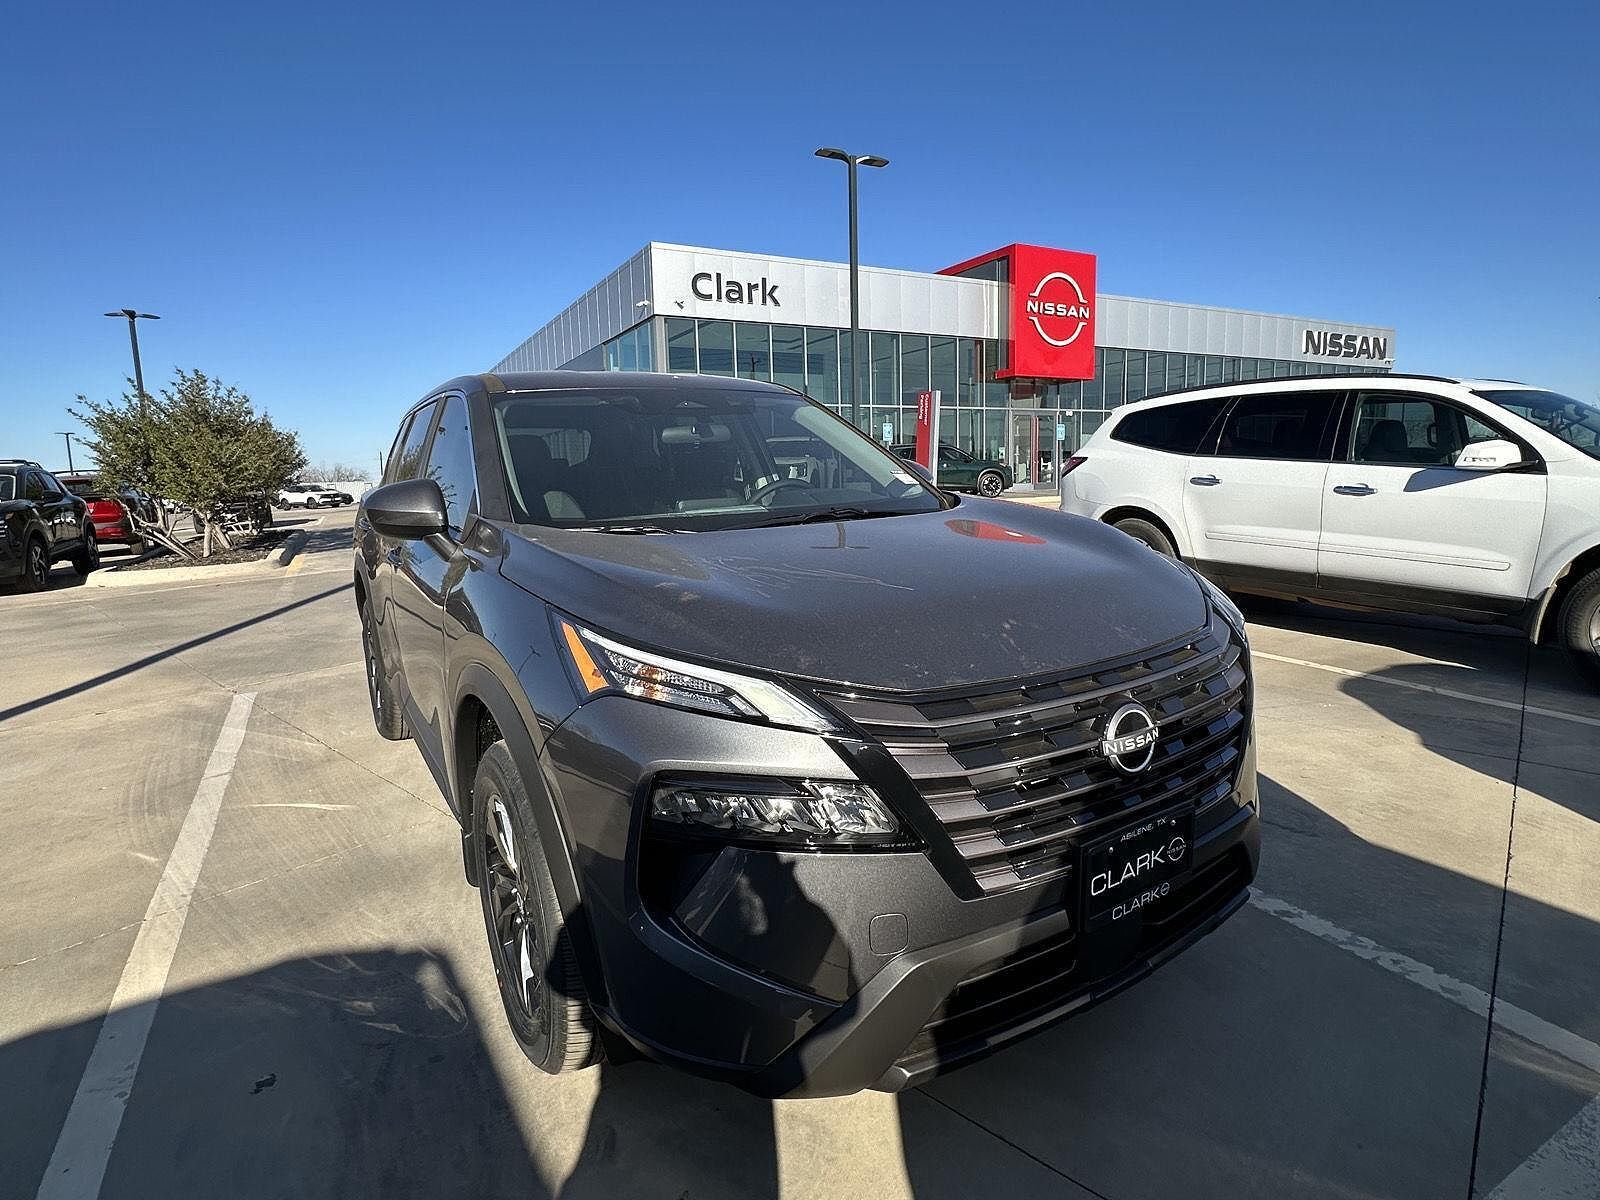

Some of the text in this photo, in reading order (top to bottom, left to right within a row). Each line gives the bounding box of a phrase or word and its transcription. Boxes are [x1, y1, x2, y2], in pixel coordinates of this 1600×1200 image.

[691, 272, 781, 307] Clark
[1026, 299, 1090, 319] NISSAN
[1302, 329, 1387, 360] NISSAN
[1104, 726, 1159, 755] NISSAN
[1090, 845, 1166, 897] CLARK
[1111, 886, 1161, 921] CLARK
